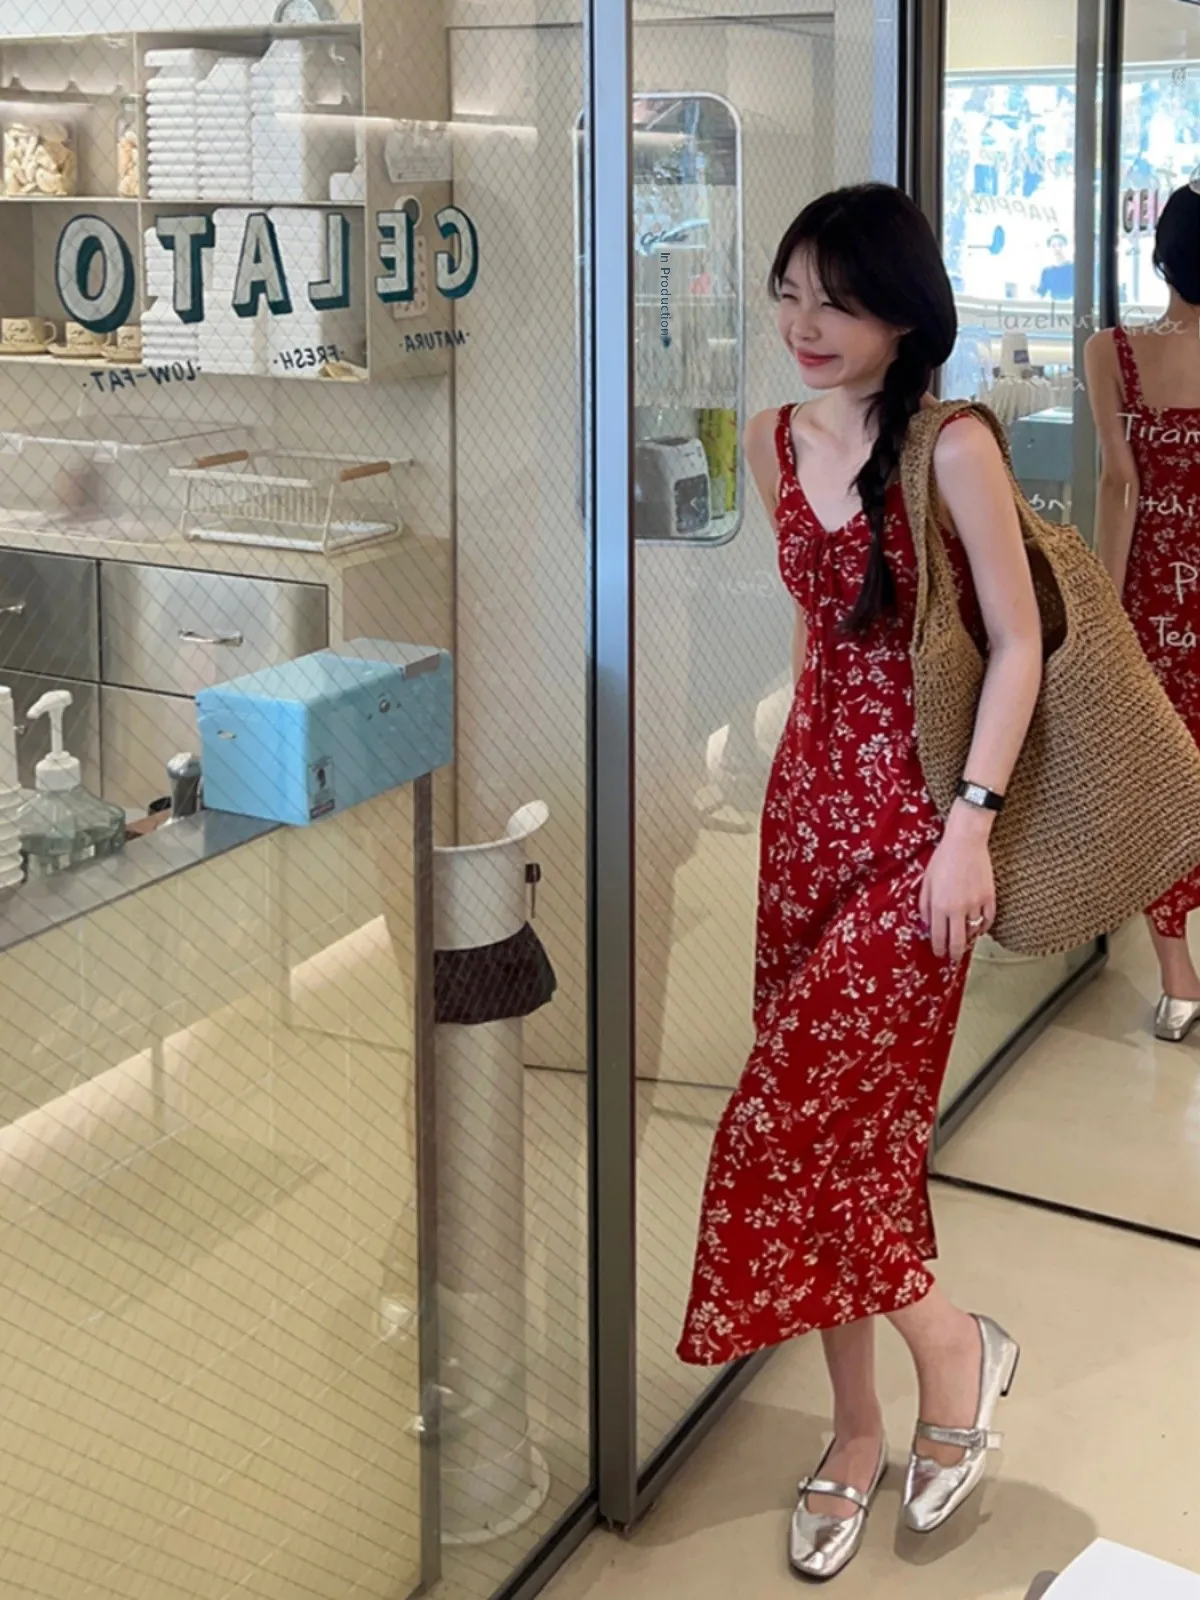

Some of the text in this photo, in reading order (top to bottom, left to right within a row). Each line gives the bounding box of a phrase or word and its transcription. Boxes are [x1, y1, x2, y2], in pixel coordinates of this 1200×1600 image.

[660, 252, 672, 336] In Production
[1148, 614, 1197, 648] Tea
